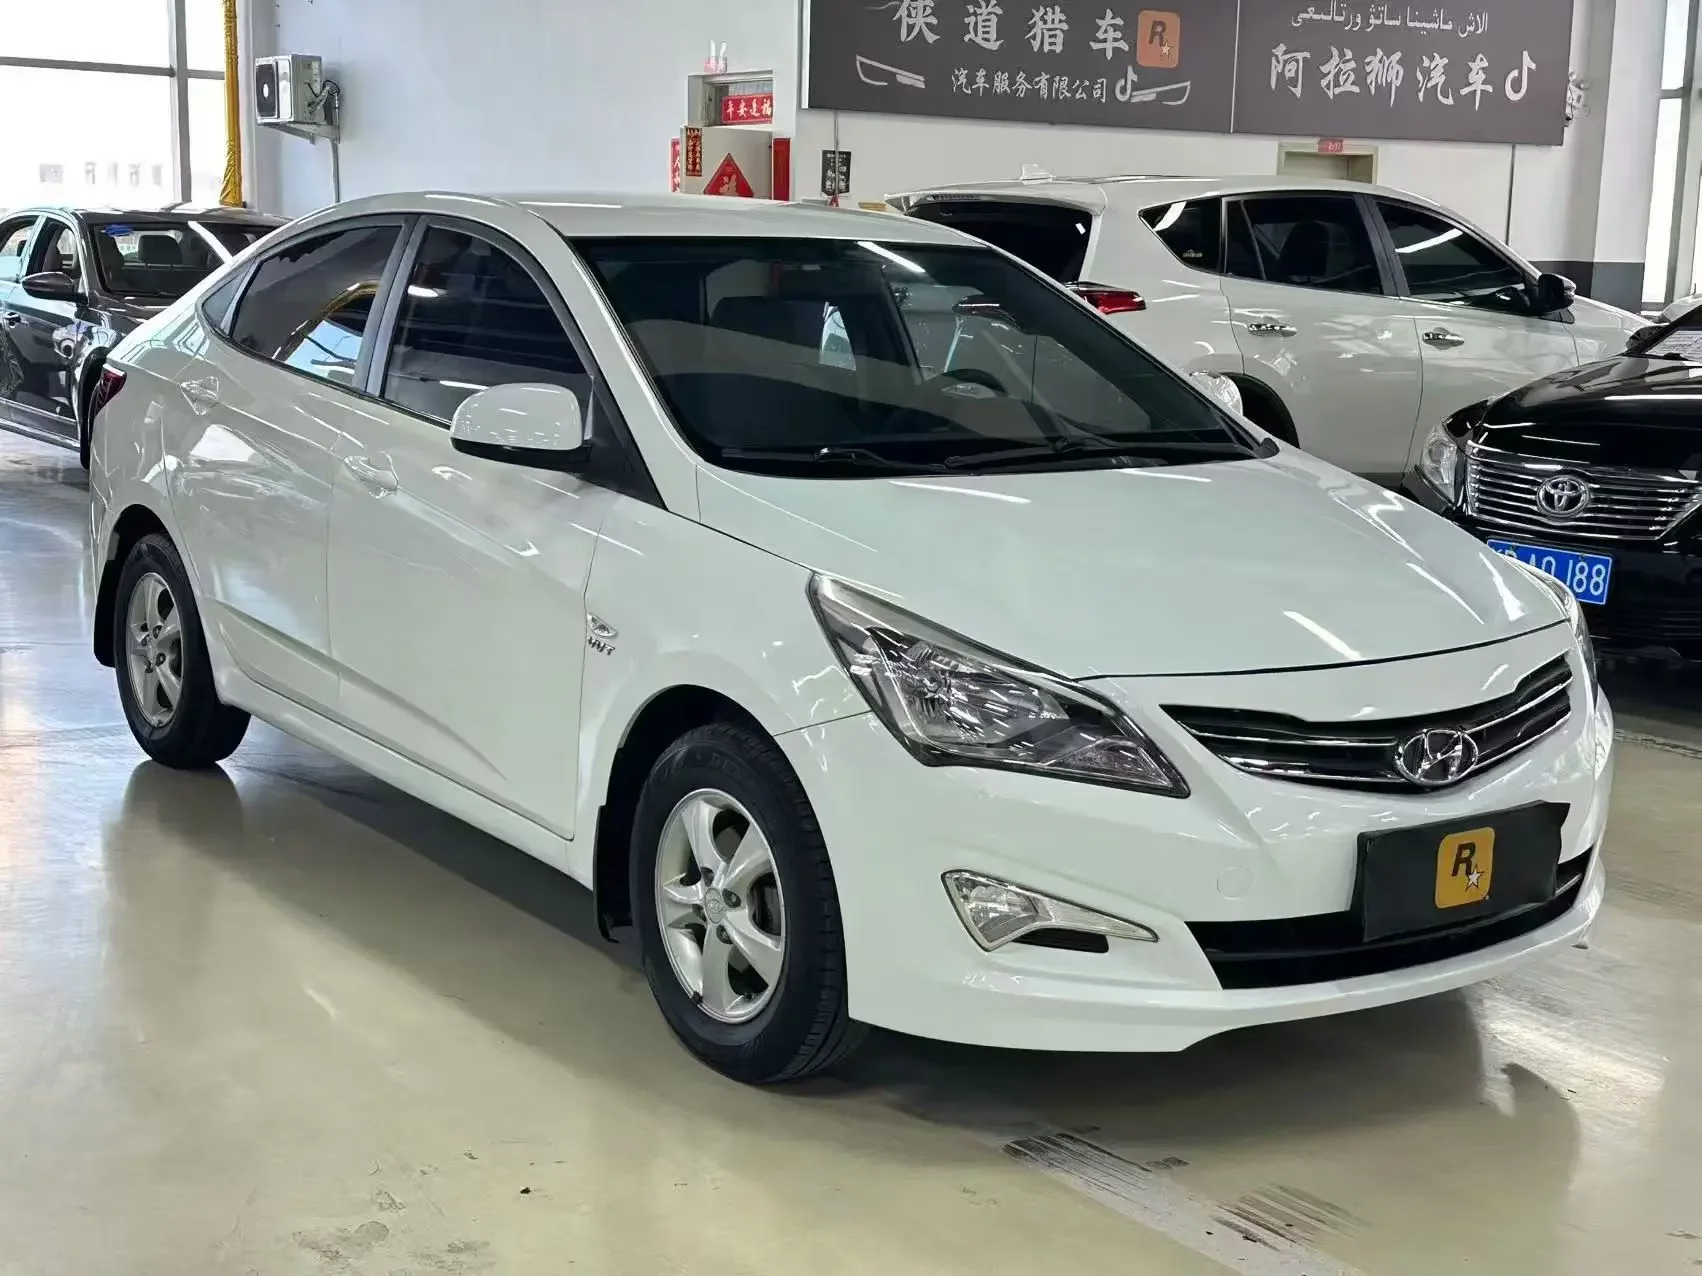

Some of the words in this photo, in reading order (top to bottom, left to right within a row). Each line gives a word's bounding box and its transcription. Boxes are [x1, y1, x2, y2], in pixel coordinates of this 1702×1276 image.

[893, 0, 1129, 60] 侠道猎车
[951, 67, 1107, 103] 汽车服务有限公司
[1270, 43, 1493, 111] 阿拉狮汽车
[1451, 842, 1476, 877] R
